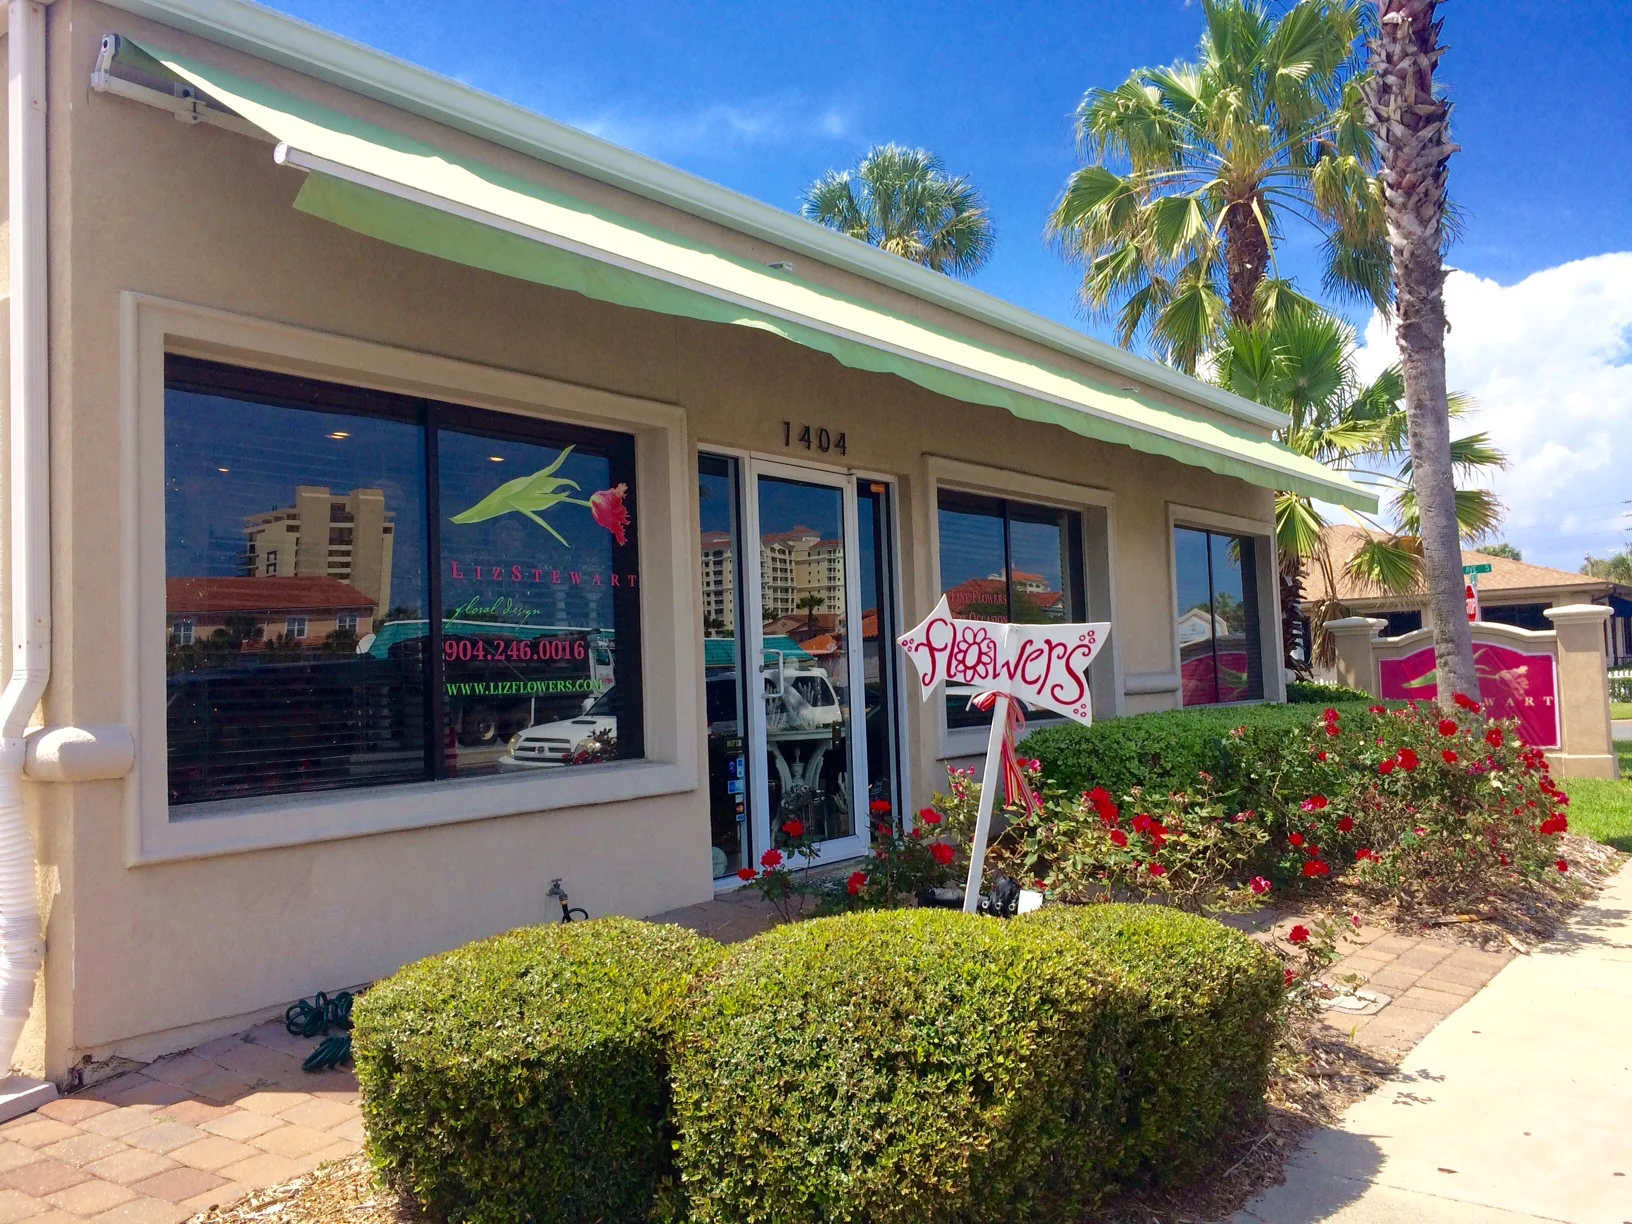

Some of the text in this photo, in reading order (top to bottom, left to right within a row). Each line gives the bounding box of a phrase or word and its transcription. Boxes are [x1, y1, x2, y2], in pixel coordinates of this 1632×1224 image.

[783, 421, 847, 456] 1404
[972, 590, 1008, 605] FLOWERS
[445, 595, 542, 629] floral design
[444, 640, 586, 661] 904.246.0016
[914, 617, 1092, 706] flowers
[446, 679, 603, 696] WWW.LIZFLOWERS.COM
[1483, 696, 1554, 707] WART
